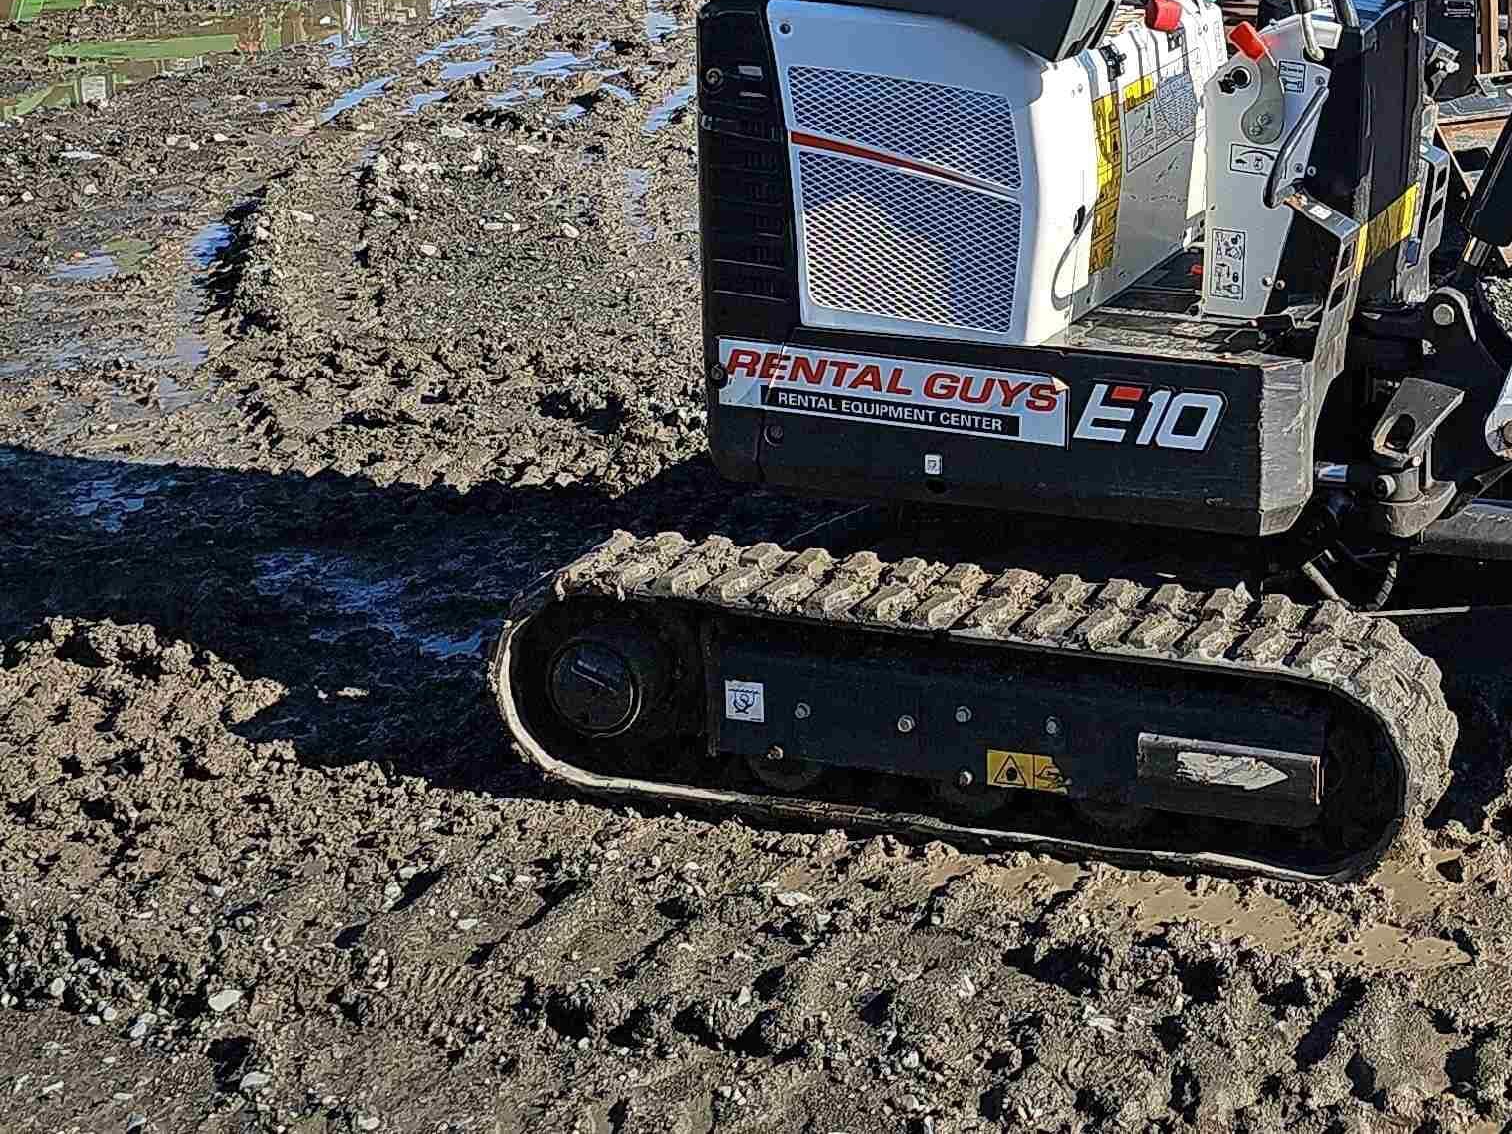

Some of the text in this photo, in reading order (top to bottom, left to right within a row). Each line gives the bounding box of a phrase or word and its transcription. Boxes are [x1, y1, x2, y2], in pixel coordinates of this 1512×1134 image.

[725, 348, 1059, 413] RENTAL GUYS
[778, 391, 1003, 433] RENTAL EQUIPMENT CENTER
[1073, 382, 1221, 450] E10
